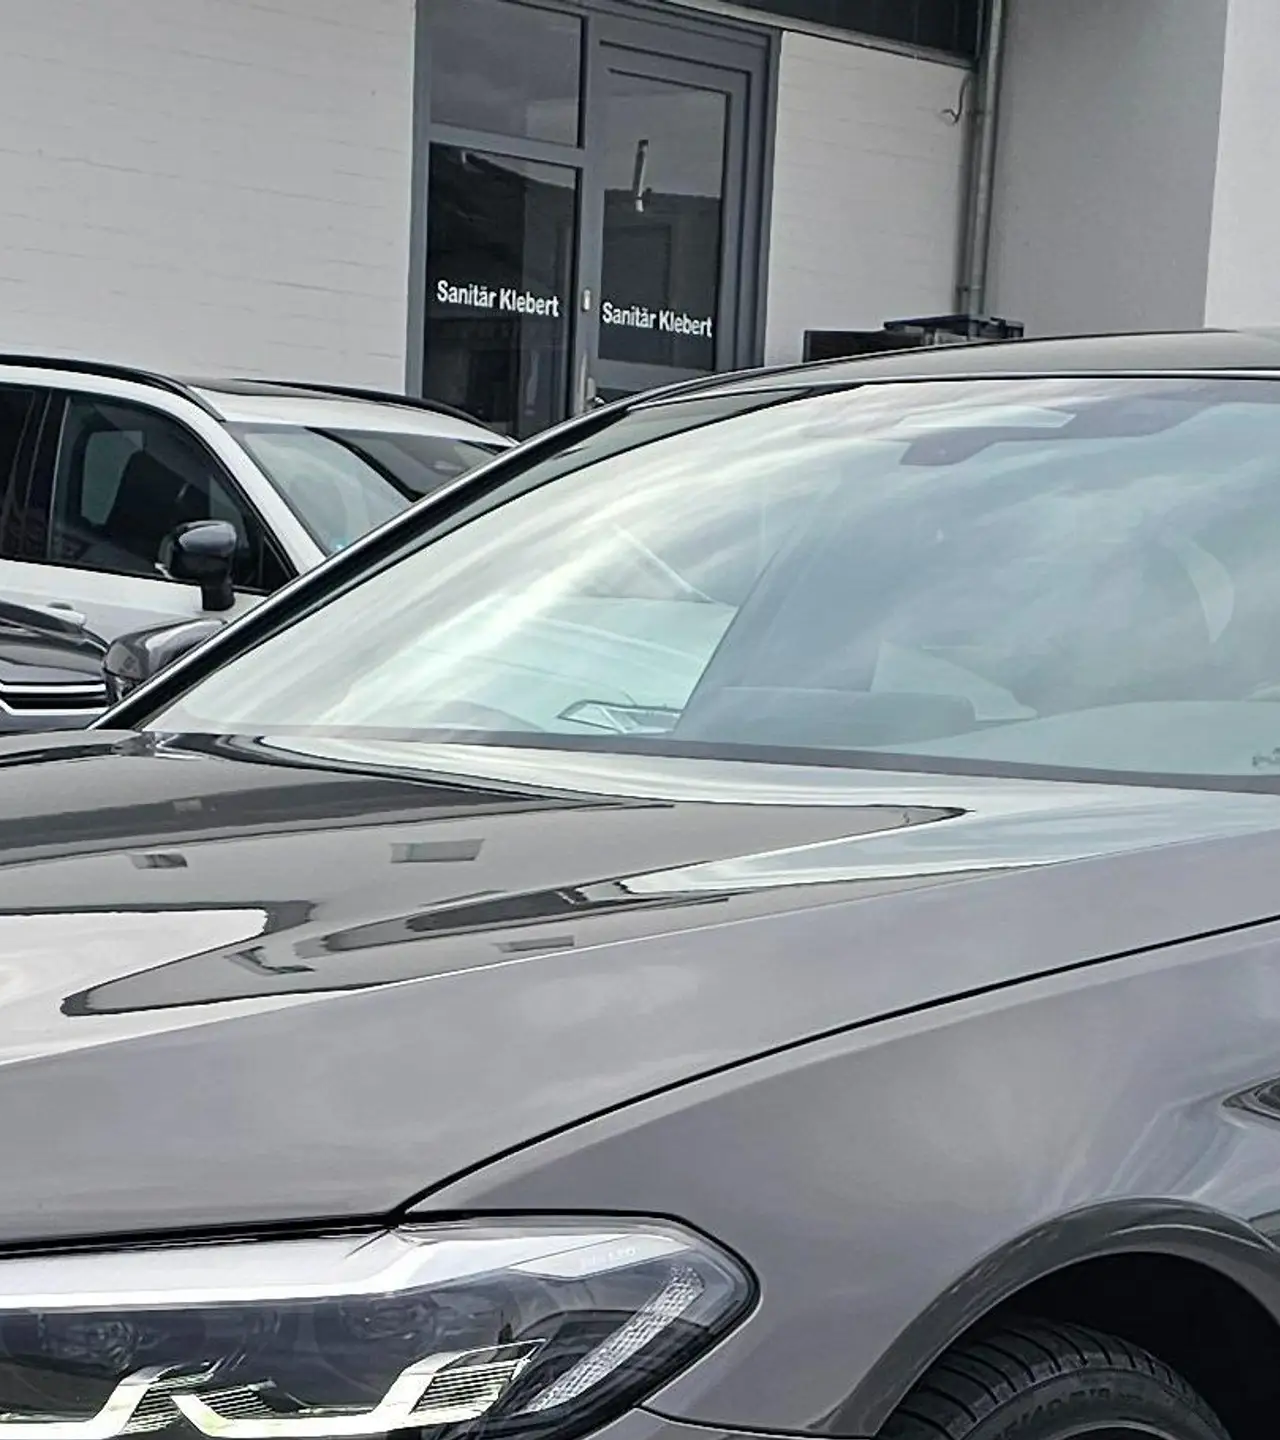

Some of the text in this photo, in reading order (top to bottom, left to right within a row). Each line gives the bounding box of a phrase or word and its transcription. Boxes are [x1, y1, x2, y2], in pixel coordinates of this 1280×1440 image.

[436, 279, 560, 318] Sanitär Klebert
[602, 301, 713, 338] Sanitär Klebert
